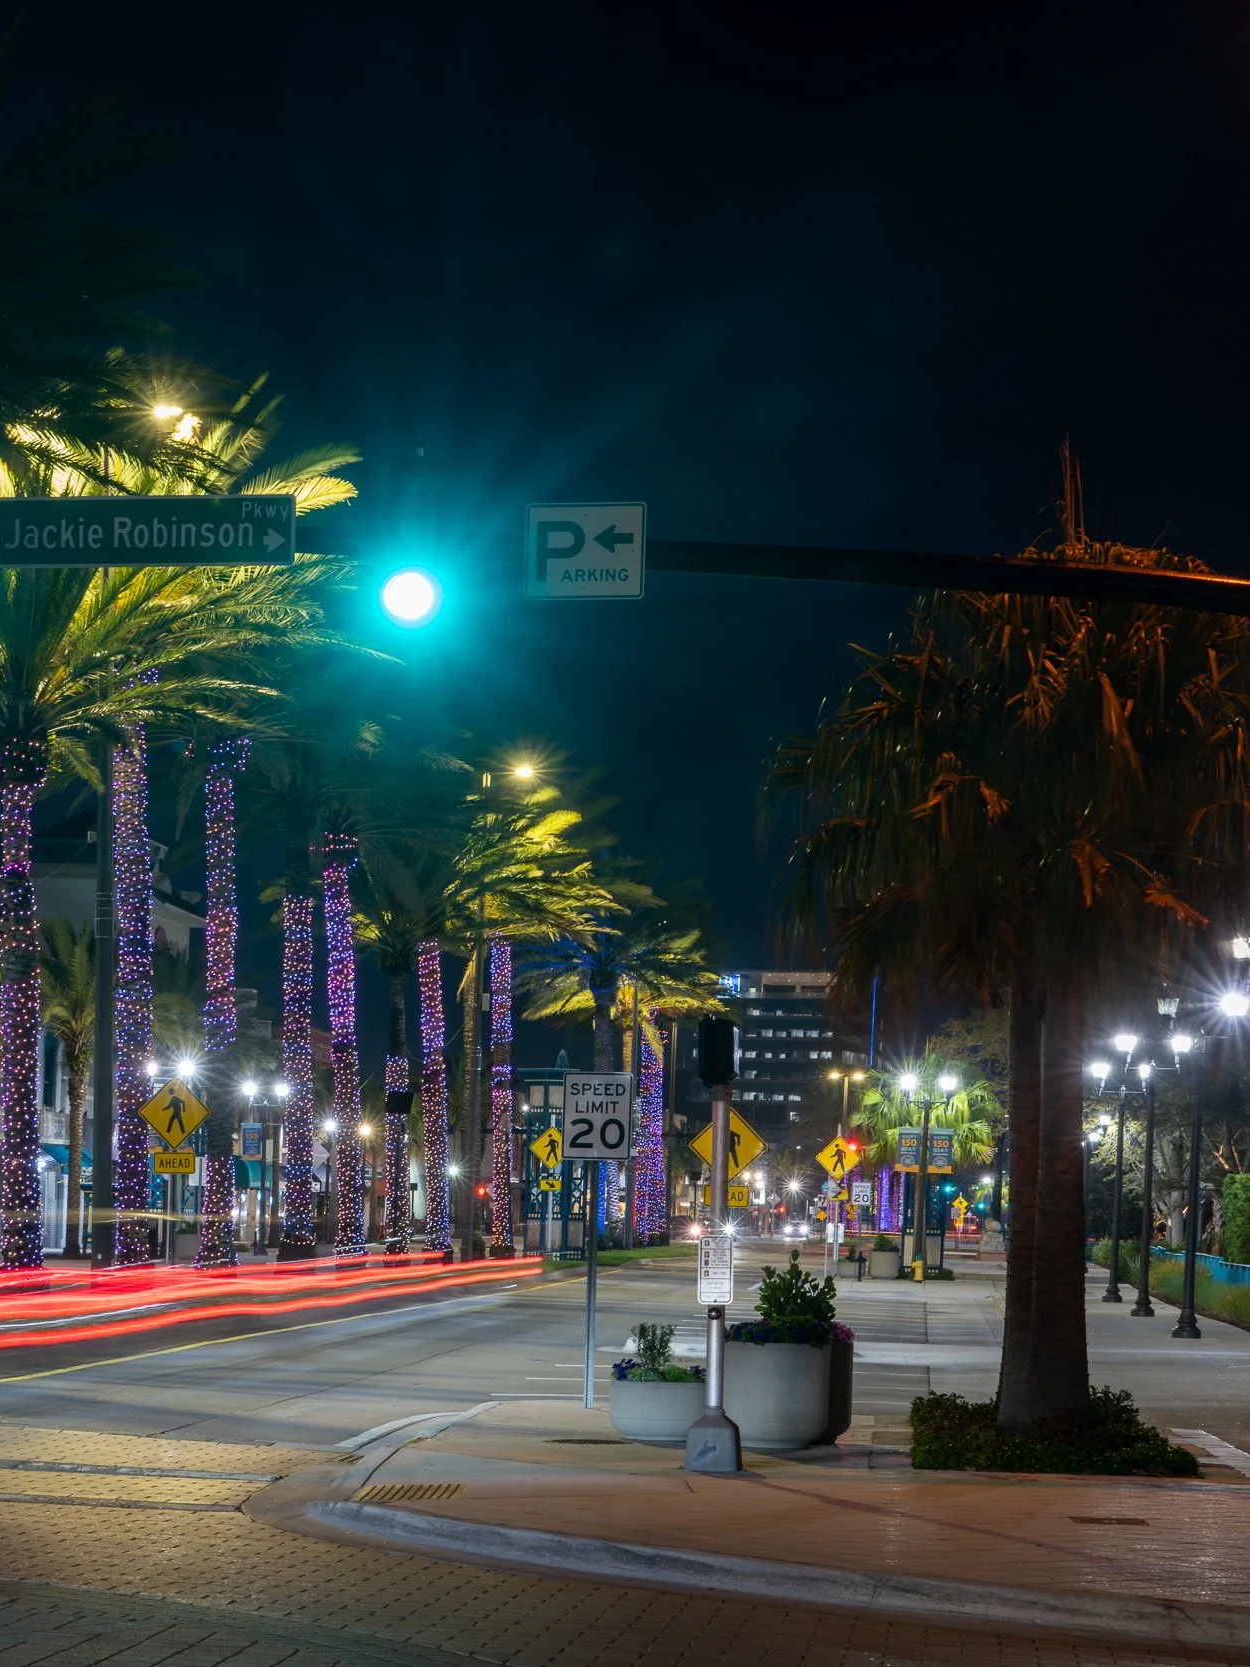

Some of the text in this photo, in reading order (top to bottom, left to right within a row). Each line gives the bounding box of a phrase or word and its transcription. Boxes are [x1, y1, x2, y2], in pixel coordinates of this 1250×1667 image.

[241, 501, 289, 523] Pkwy
[4, 516, 253, 549] Jackie Robinson
[570, 1083, 626, 1096] SPEED
[575, 1100, 619, 1114] LIMIT
[245, 1132, 259, 1140] 150
[569, 1117, 626, 1150] 20
[901, 1139, 918, 1147] 150
[933, 1140, 950, 1148] 150
[158, 1158, 190, 1169] AHEAD
[854, 1194, 869, 1202] 20
